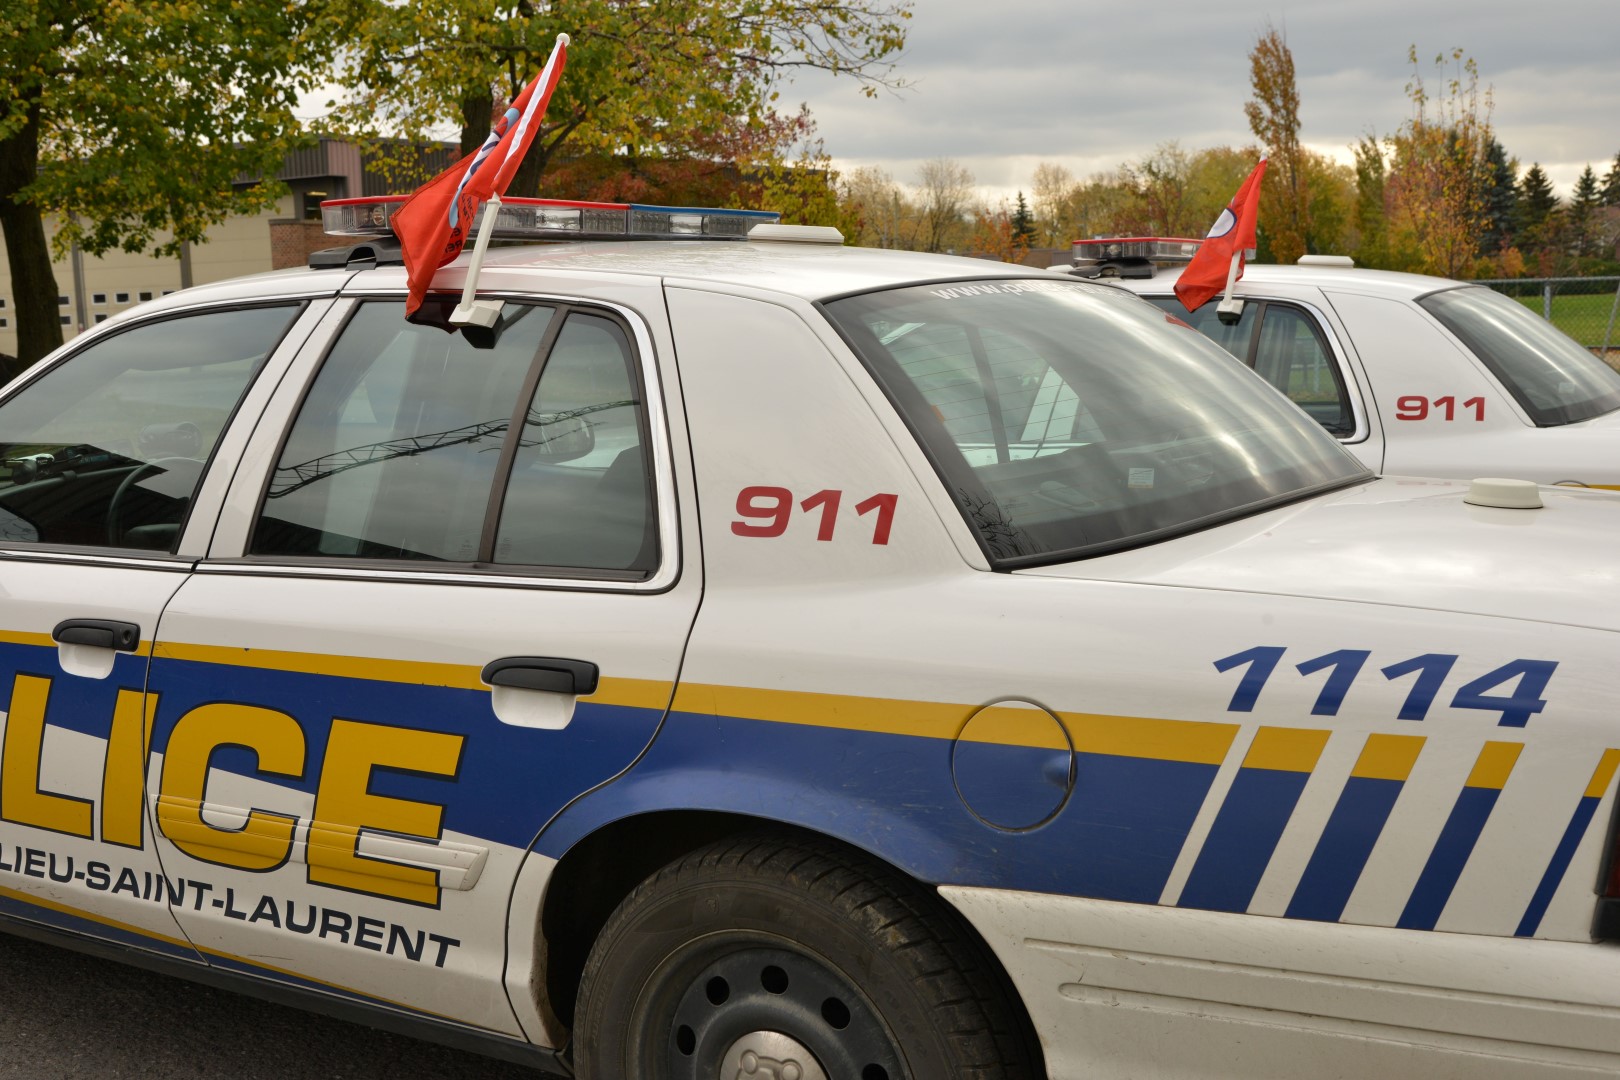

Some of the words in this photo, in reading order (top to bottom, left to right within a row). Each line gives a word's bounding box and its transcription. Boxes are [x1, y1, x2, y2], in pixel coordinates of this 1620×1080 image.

[1395, 395, 1485, 421] 911
[731, 486, 898, 545] 911
[1213, 646, 1559, 728] 1114
[0, 670, 469, 910] LICE
[0, 843, 460, 968] LIEU-SAINT-LAURENT
